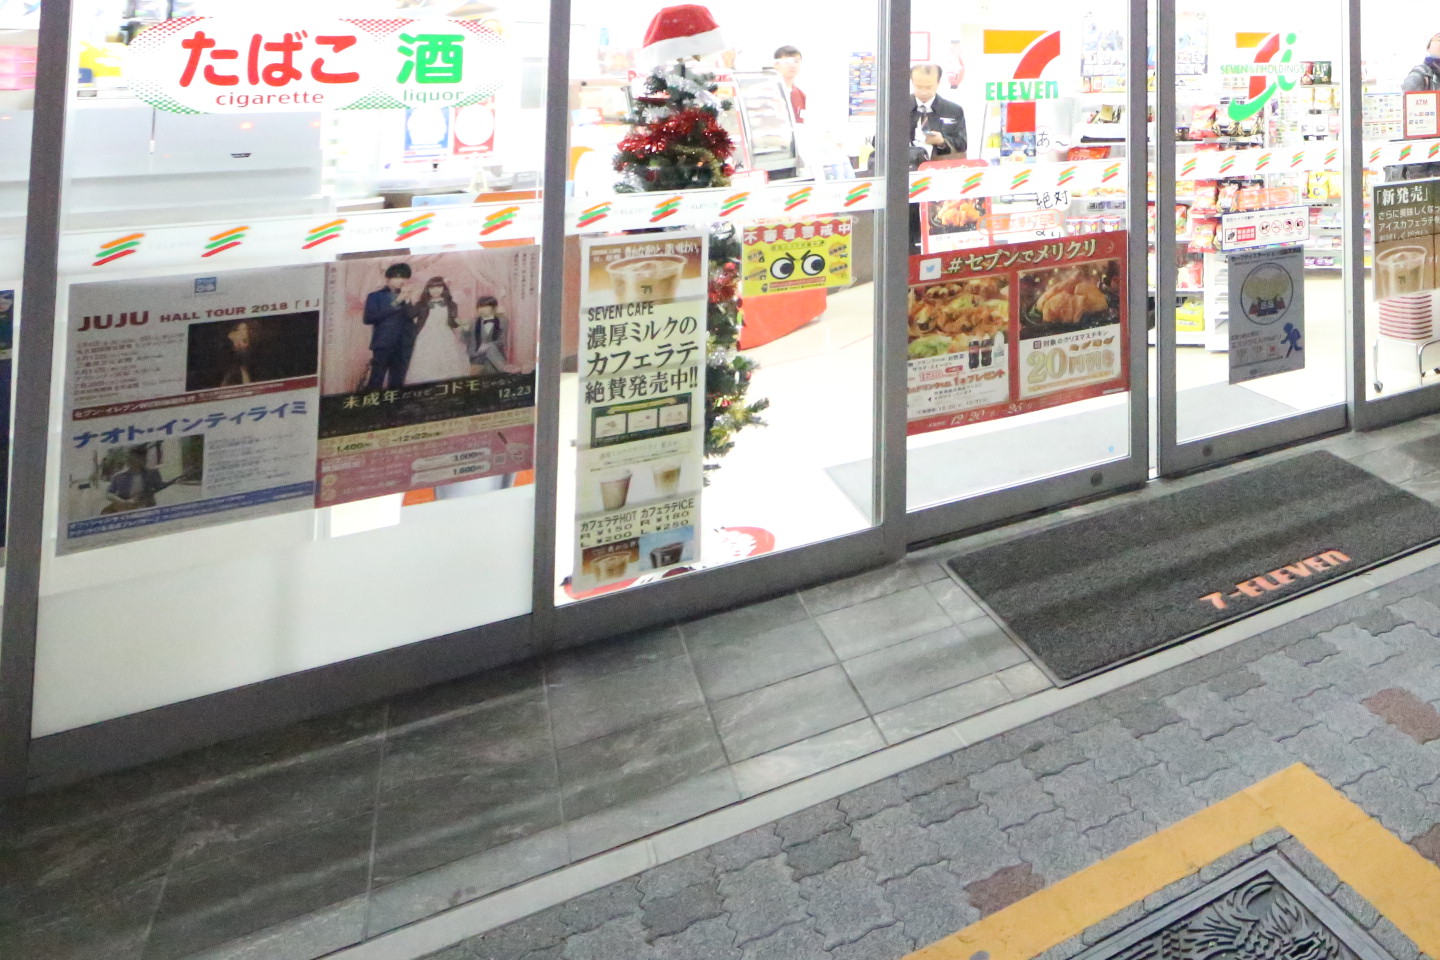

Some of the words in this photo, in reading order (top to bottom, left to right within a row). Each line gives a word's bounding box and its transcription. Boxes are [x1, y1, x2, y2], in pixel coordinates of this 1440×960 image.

[179, 30, 360, 87] たばこ
[396, 33, 465, 84] 酒
[216, 91, 324, 107] cigarette
[402, 87, 464, 103] liquor
[77, 310, 149, 332] JUJU
[160, 311, 200, 323] HALL
[204, 306, 246, 318] TOUR
[251, 301, 288, 314] 2018
[588, 304, 623, 322] SEVEN
[586, 315, 698, 350] 濃厚ミルクの
[586, 340, 699, 378] カフェラテ
[73, 401, 307, 448] ナオト・インティライミ
